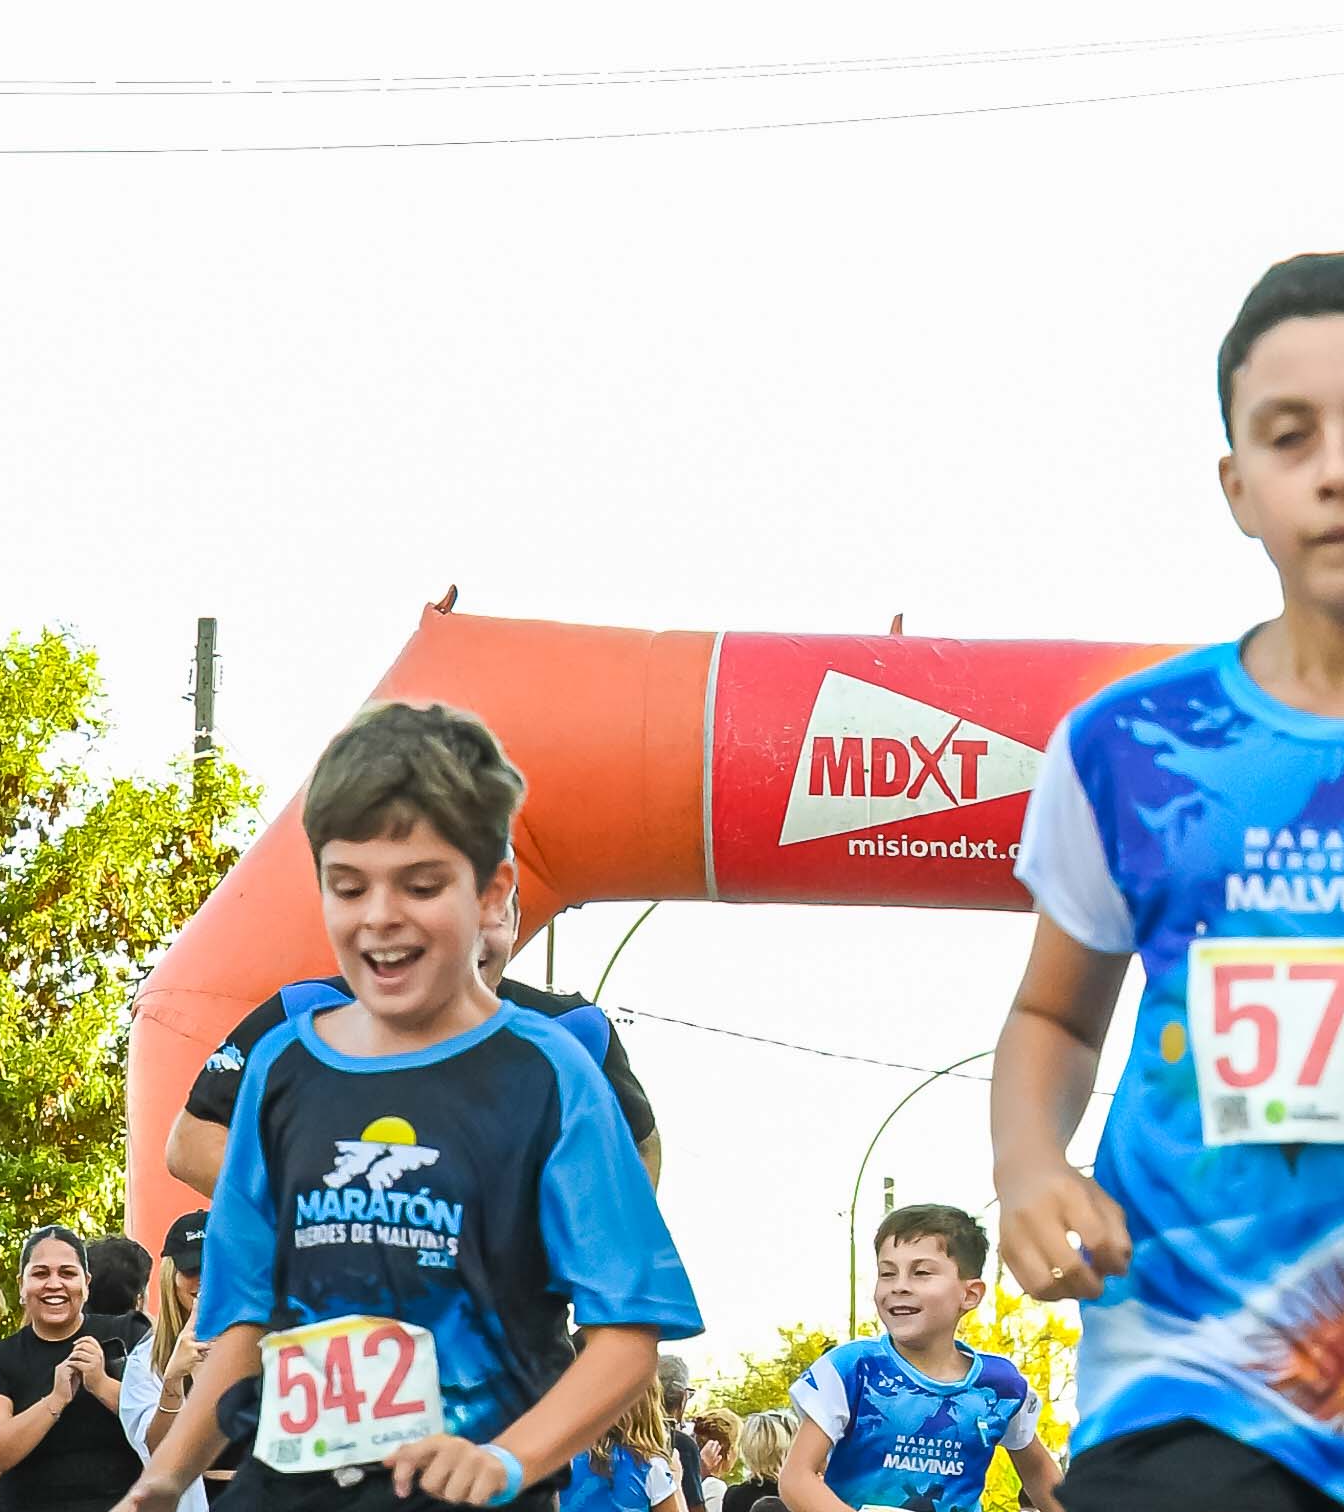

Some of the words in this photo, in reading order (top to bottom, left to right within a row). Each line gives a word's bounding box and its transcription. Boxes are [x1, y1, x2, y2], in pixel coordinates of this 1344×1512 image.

[807, 719, 988, 806] MDXT
[296, 1186, 464, 1235] MARATÓN
[278, 1322, 426, 1435] 542
[882, 1453, 964, 1476] MALVINAS
